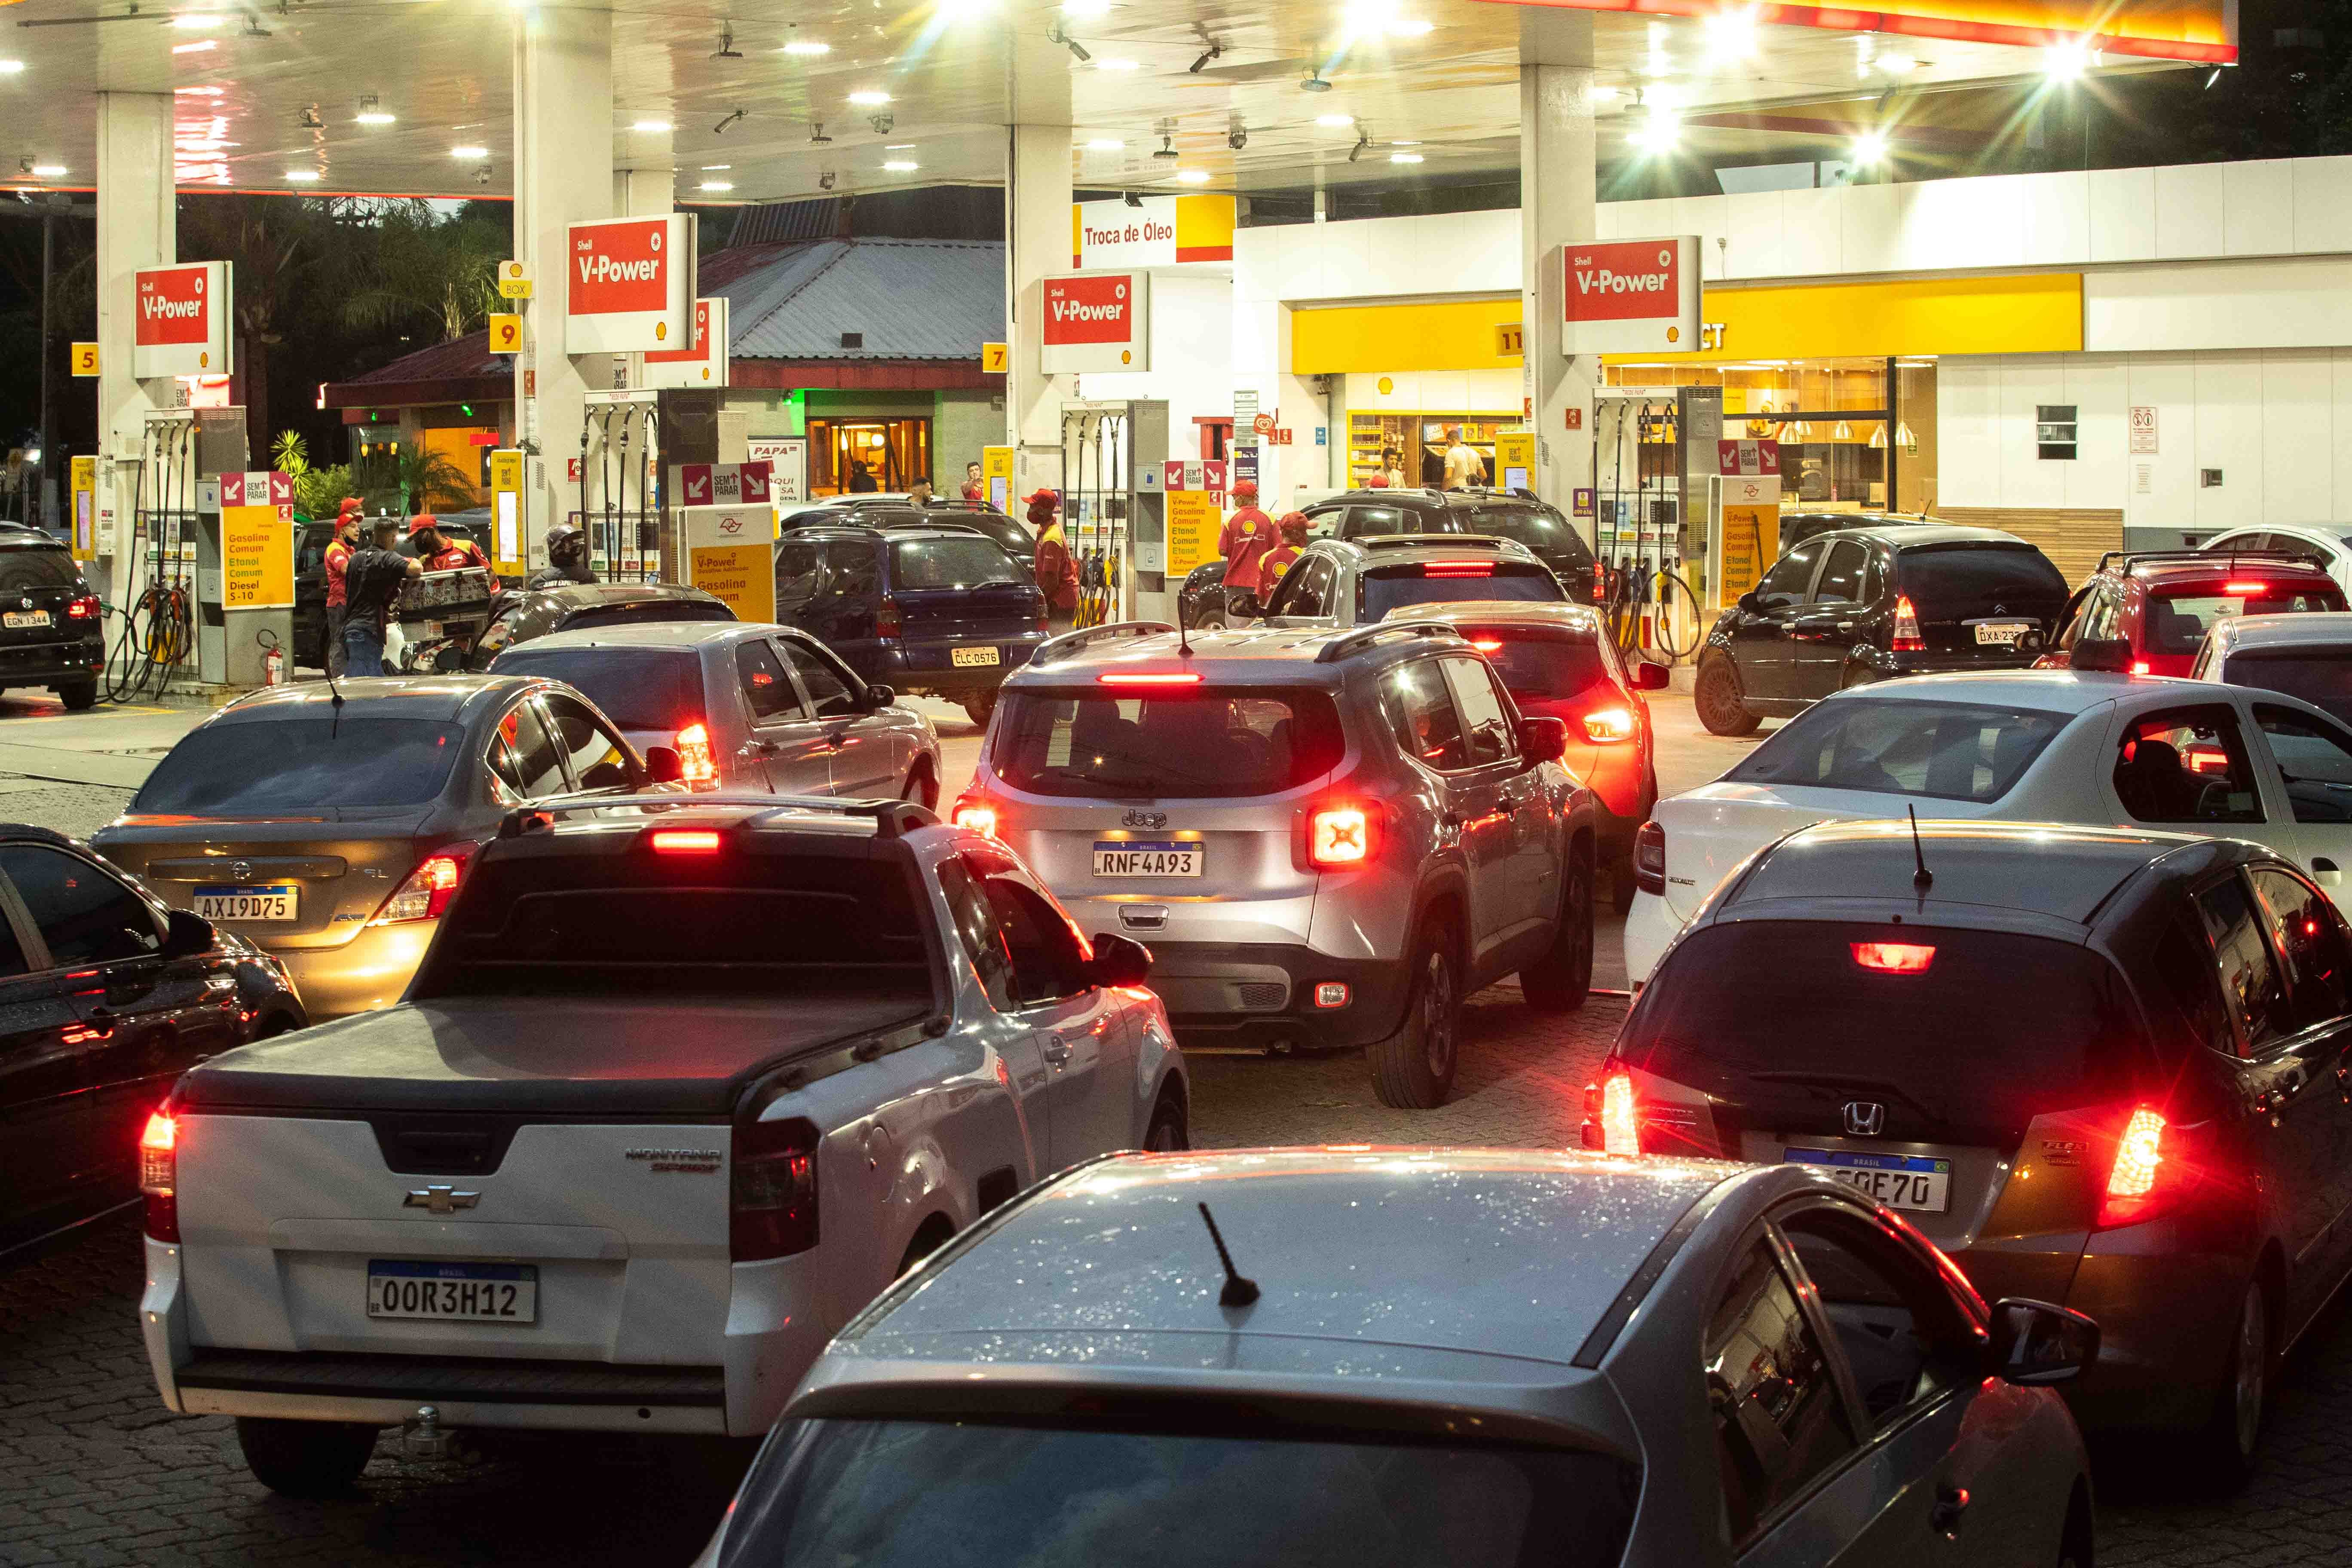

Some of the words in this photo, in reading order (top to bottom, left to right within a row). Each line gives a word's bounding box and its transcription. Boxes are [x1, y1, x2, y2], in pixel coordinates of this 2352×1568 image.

[1085, 227, 1120, 245] Troca
[1124, 224, 1139, 242] de
[1144, 217, 1172, 241] Óleo
[577, 239, 592, 251] Shell
[1574, 256, 1592, 266] Shell
[579, 255, 659, 284] V-Power
[141, 282, 154, 292] Shell
[1576, 270, 1669, 295] V-Power
[506, 285, 526, 295] BOX
[1051, 288, 1064, 297] Shell
[143, 296, 202, 320] V-Power
[1052, 300, 1123, 322] V-Power
[501, 325, 515, 344] 9
[1503, 332, 1522, 349] 11
[83, 352, 93, 368] 5
[993, 351, 1004, 366] 7
[754, 447, 788, 455] PAPA
[1741, 449, 1751, 458] SEM
[714, 475, 730, 486] SEM
[247, 482, 260, 491] SEM
[714, 484, 739, 496] PARAR
[247, 491, 267, 499] PARAR
[1172, 508, 1205, 516] Gasolina
[229, 534, 270, 543] Gasolina
[229, 545, 264, 553] Comum
[229, 557, 259, 567] Etanol
[697, 558, 736, 569] V-Power
[1726, 556, 1751, 564] Etanol
[229, 569, 263, 578] Comum
[230, 580, 259, 590] Diesel
[697, 579, 746, 591] Gasolina
[1726, 579, 1750, 588] Etanol
[1122, 809, 1167, 829] Jeep
[1103, 853, 1192, 873] RNF4A93
[625, 1148, 722, 1160] MONTANA
